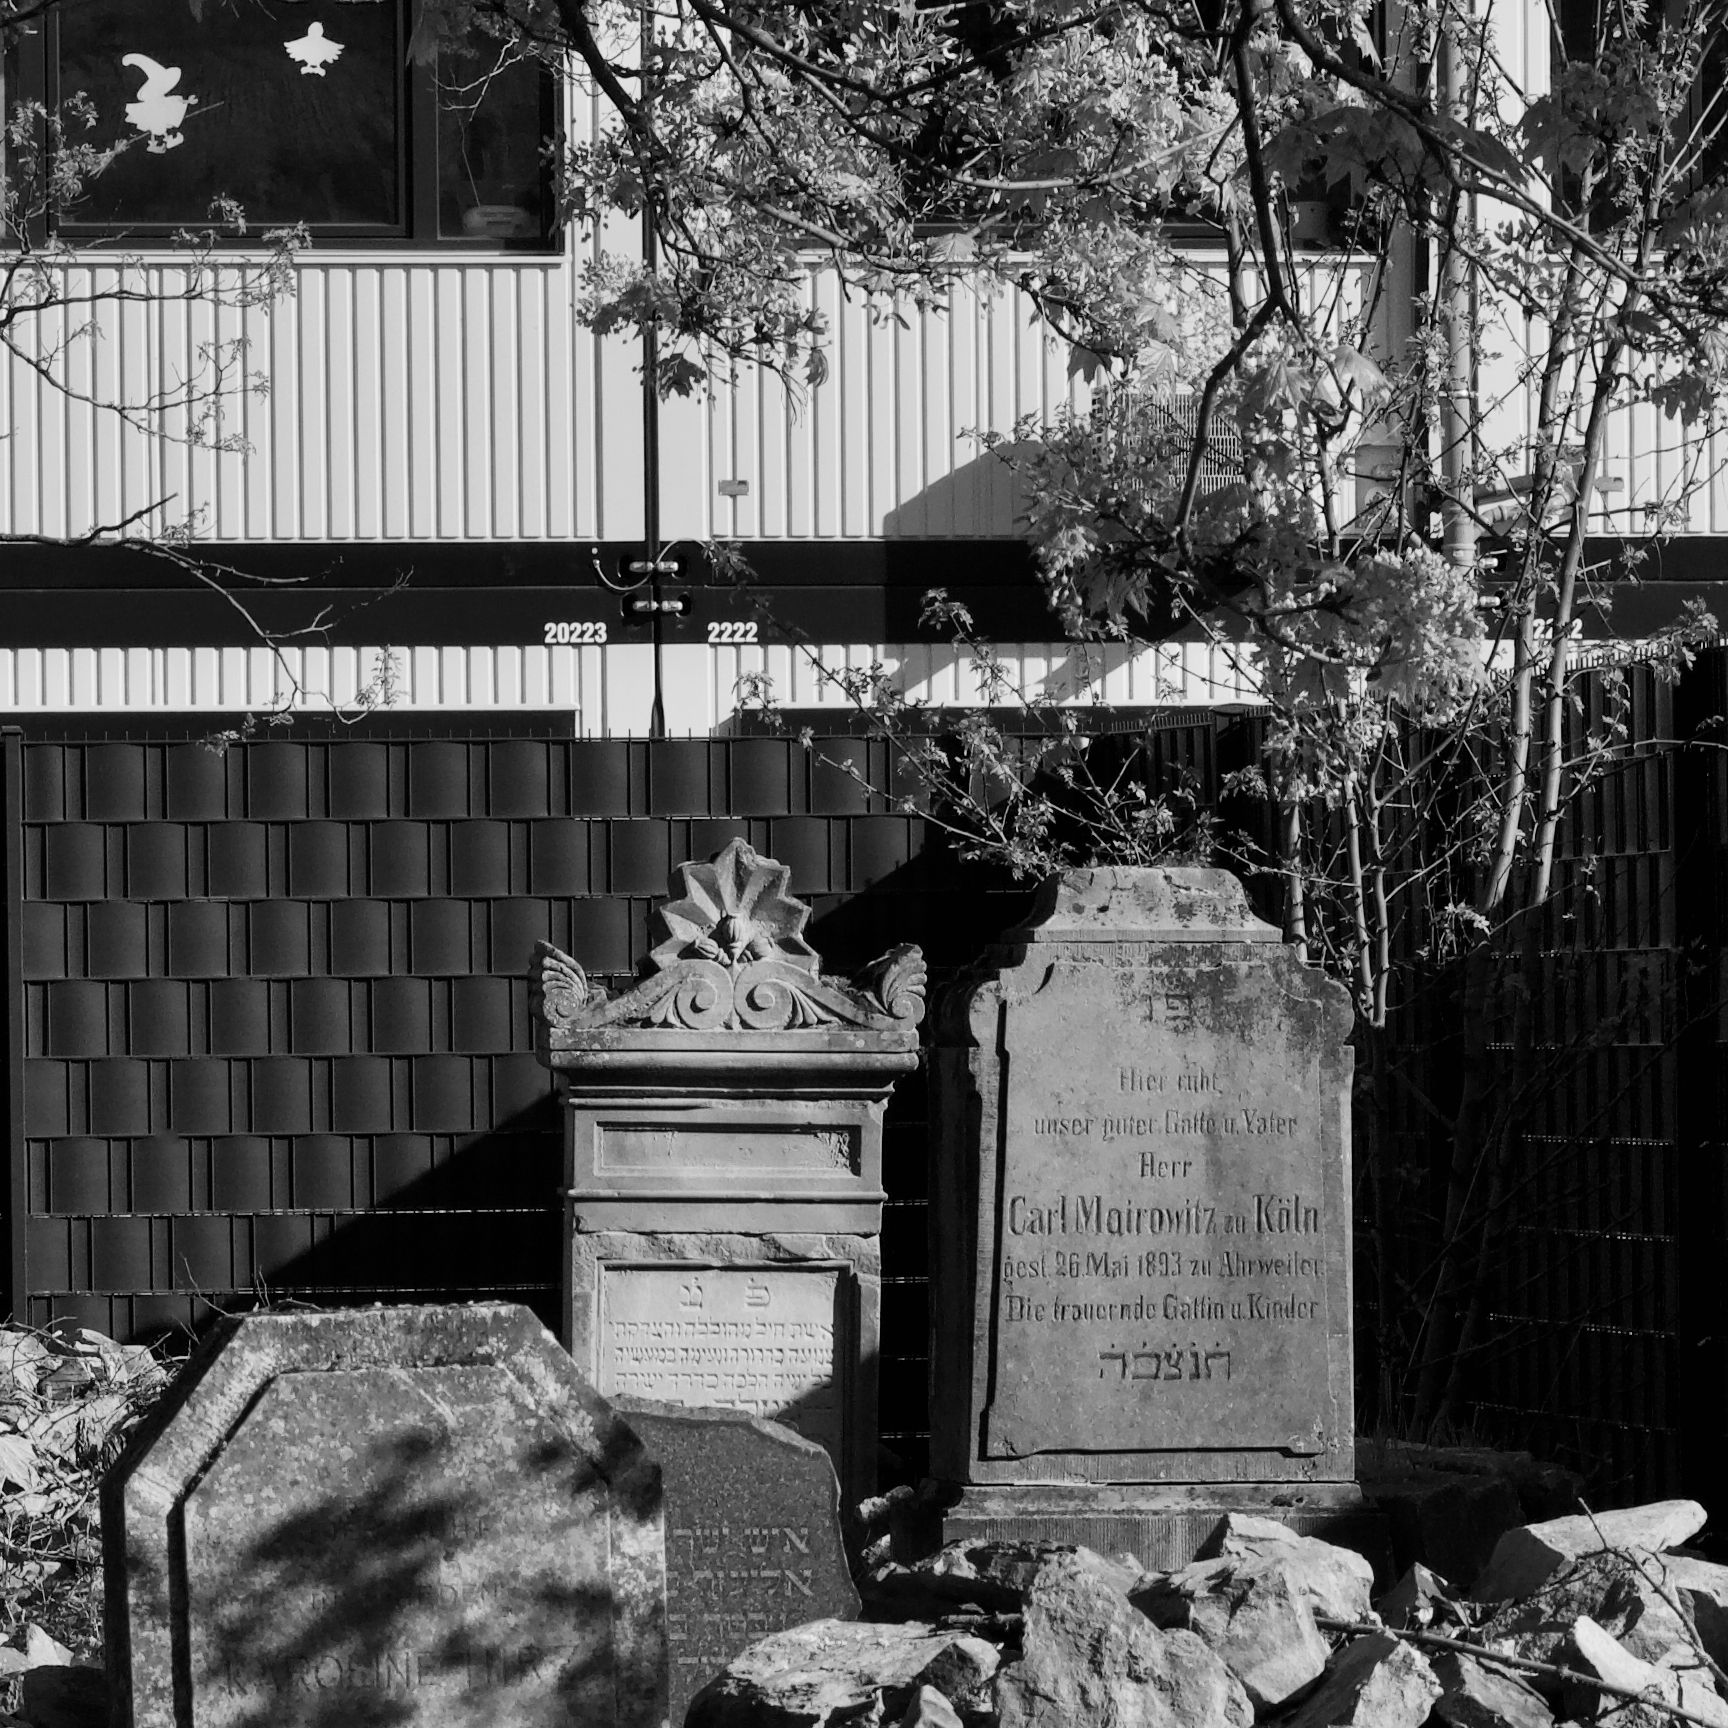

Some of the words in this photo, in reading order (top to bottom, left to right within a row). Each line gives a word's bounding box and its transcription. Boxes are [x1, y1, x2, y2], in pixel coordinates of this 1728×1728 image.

[543, 621, 608, 644] 20223
[707, 621, 759, 644] 2222
[1120, 1068, 1167, 1092] Hier
[1034, 1117, 1094, 1136] unser
[1102, 1113, 1155, 1141] guter
[1165, 1109, 1216, 1136] Gatte
[1242, 1108, 1297, 1136] Vater
[1138, 1151, 1192, 1178] Herr
[1008, 1195, 1066, 1236] Carl
[1223, 1213, 1246, 1234] zu
[1253, 1194, 1318, 1236] Köln
[1086, 1251, 1129, 1278] Mai
[1137, 1251, 1182, 1277] 1893
[1189, 1257, 1212, 1277] zu
[1005, 1295, 1044, 1322] Die
[1053, 1295, 1156, 1321] trauernde
[1163, 1293, 1224, 1321] Gattin
[1246, 1293, 1319, 1320] Kinder
